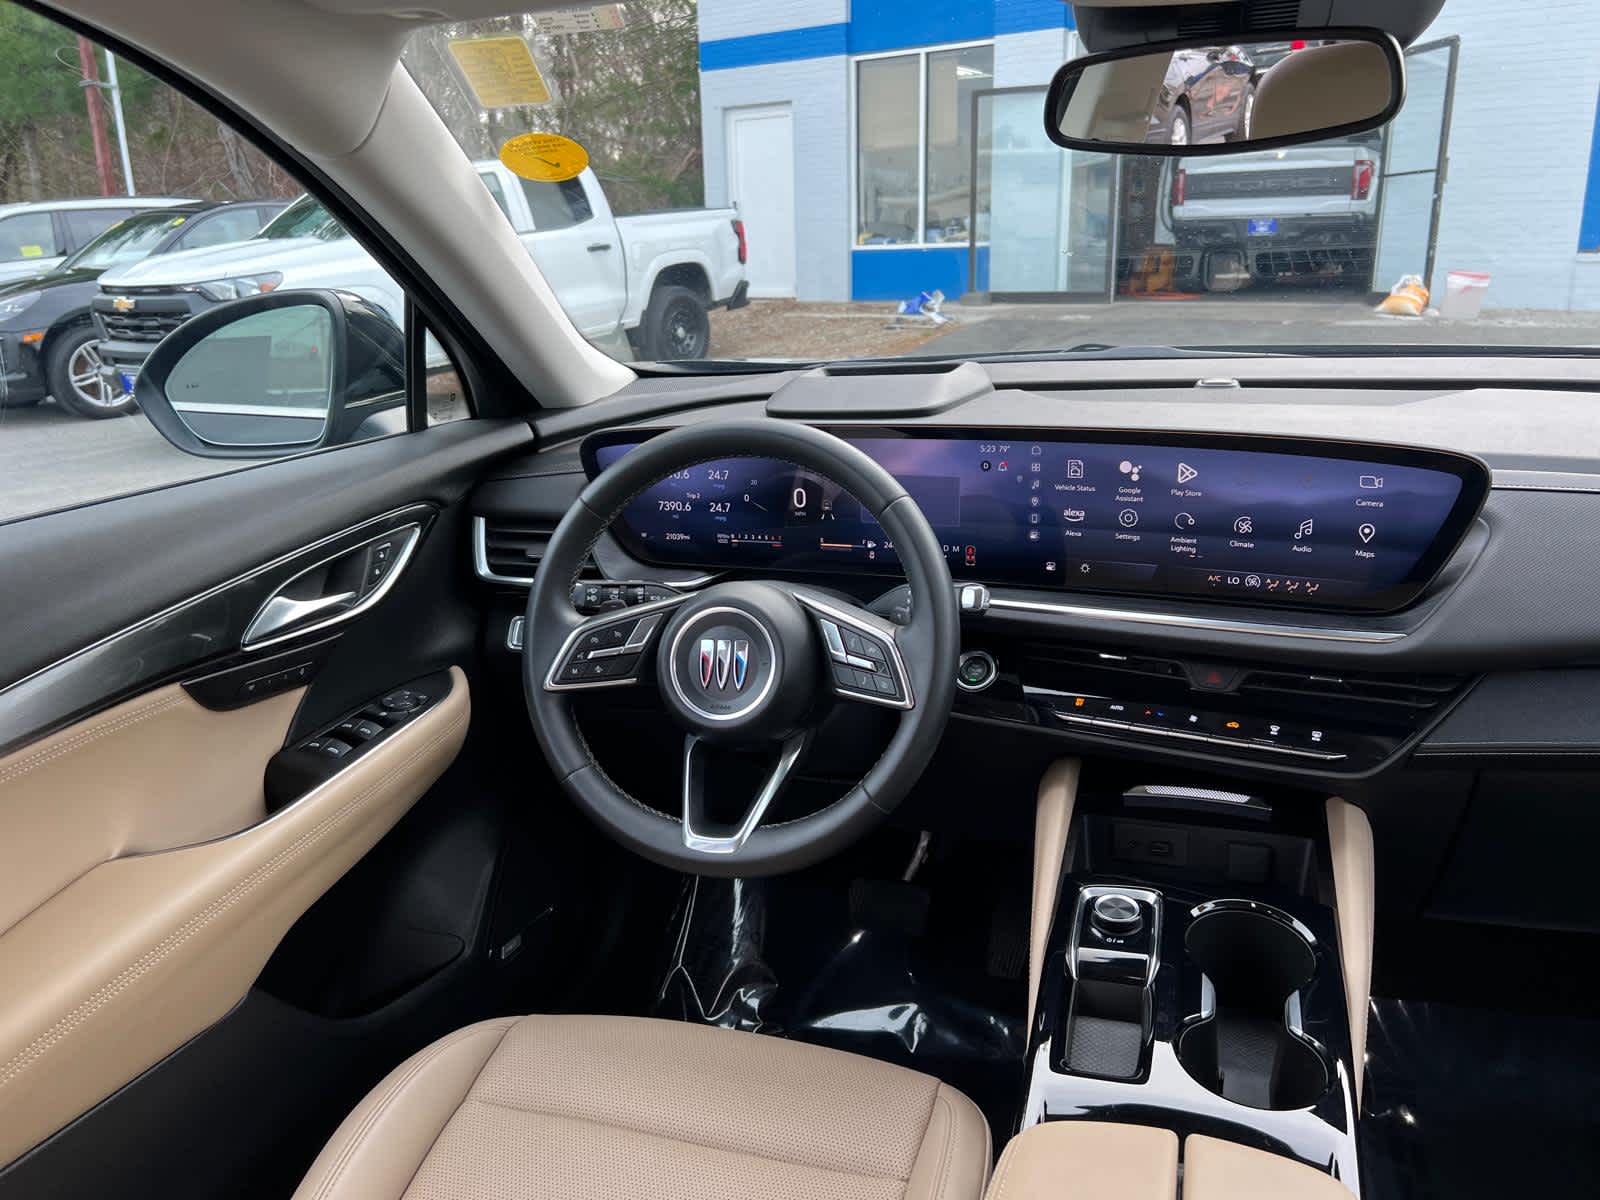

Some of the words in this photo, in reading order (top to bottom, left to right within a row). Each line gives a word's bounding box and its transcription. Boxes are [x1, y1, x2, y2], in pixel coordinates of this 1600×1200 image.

[980, 445, 996, 453] 5:23
[708, 470, 729, 480] 24.7
[1054, 484, 1075, 492] Vehicle
[1118, 487, 1142, 496] Google
[744, 494, 750, 502] 0
[793, 488, 806, 508] 0
[1170, 489, 1183, 498] Play
[1183, 489, 1202, 497] Store
[1115, 495, 1144, 503] Assistant
[1355, 499, 1384, 508] Camera
[658, 500, 692, 512] 7390.6
[709, 502, 731, 513] 24.7
[1115, 533, 1141, 542] Settings
[1170, 537, 1197, 545] Ambient
[952, 545, 960, 553] M
[1229, 540, 1255, 549] Climate
[1292, 545, 1312, 553] Audio
[1170, 545, 1197, 554] Lighting
[1355, 550, 1376, 559] Maps
[1227, 576, 1240, 585] LO
